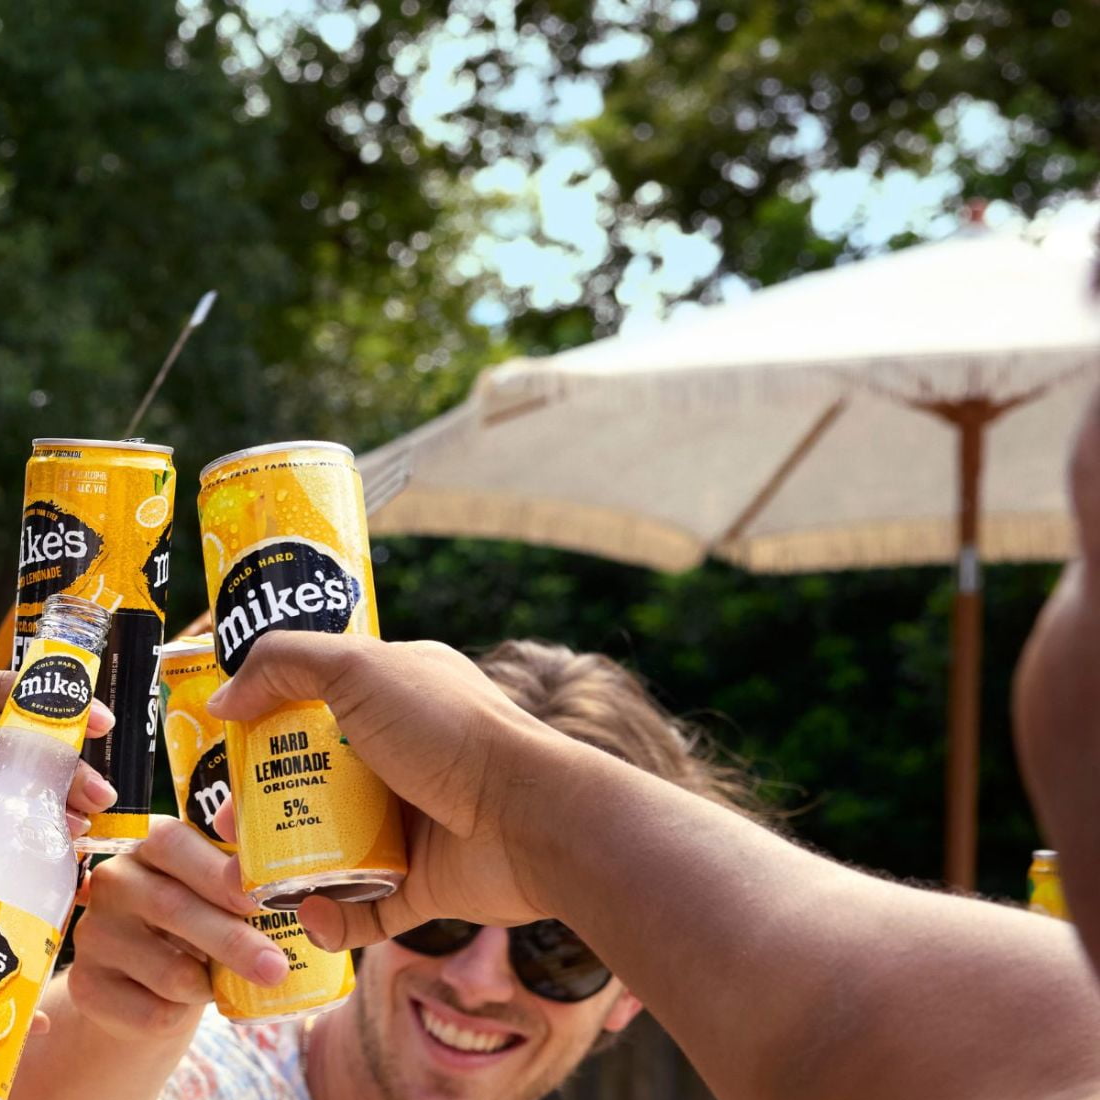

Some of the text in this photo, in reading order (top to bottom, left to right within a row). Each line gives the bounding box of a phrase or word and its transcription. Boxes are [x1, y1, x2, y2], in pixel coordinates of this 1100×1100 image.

[230, 466, 260, 479] FROM
[258, 552, 298, 569] HARD.
[26, 565, 62, 586] LEMONADE
[218, 570, 348, 661] mike's
[17, 671, 89, 704] mike's
[269, 731, 309, 755] HARD
[208, 753, 227, 770] COL
[255, 752, 332, 783] LEMONADE
[263, 775, 328, 794] ORIGINAL
[283, 798, 309, 818] 5%
[275, 816, 323, 831] ALC/VOL
[244, 911, 298, 932] EMONA
